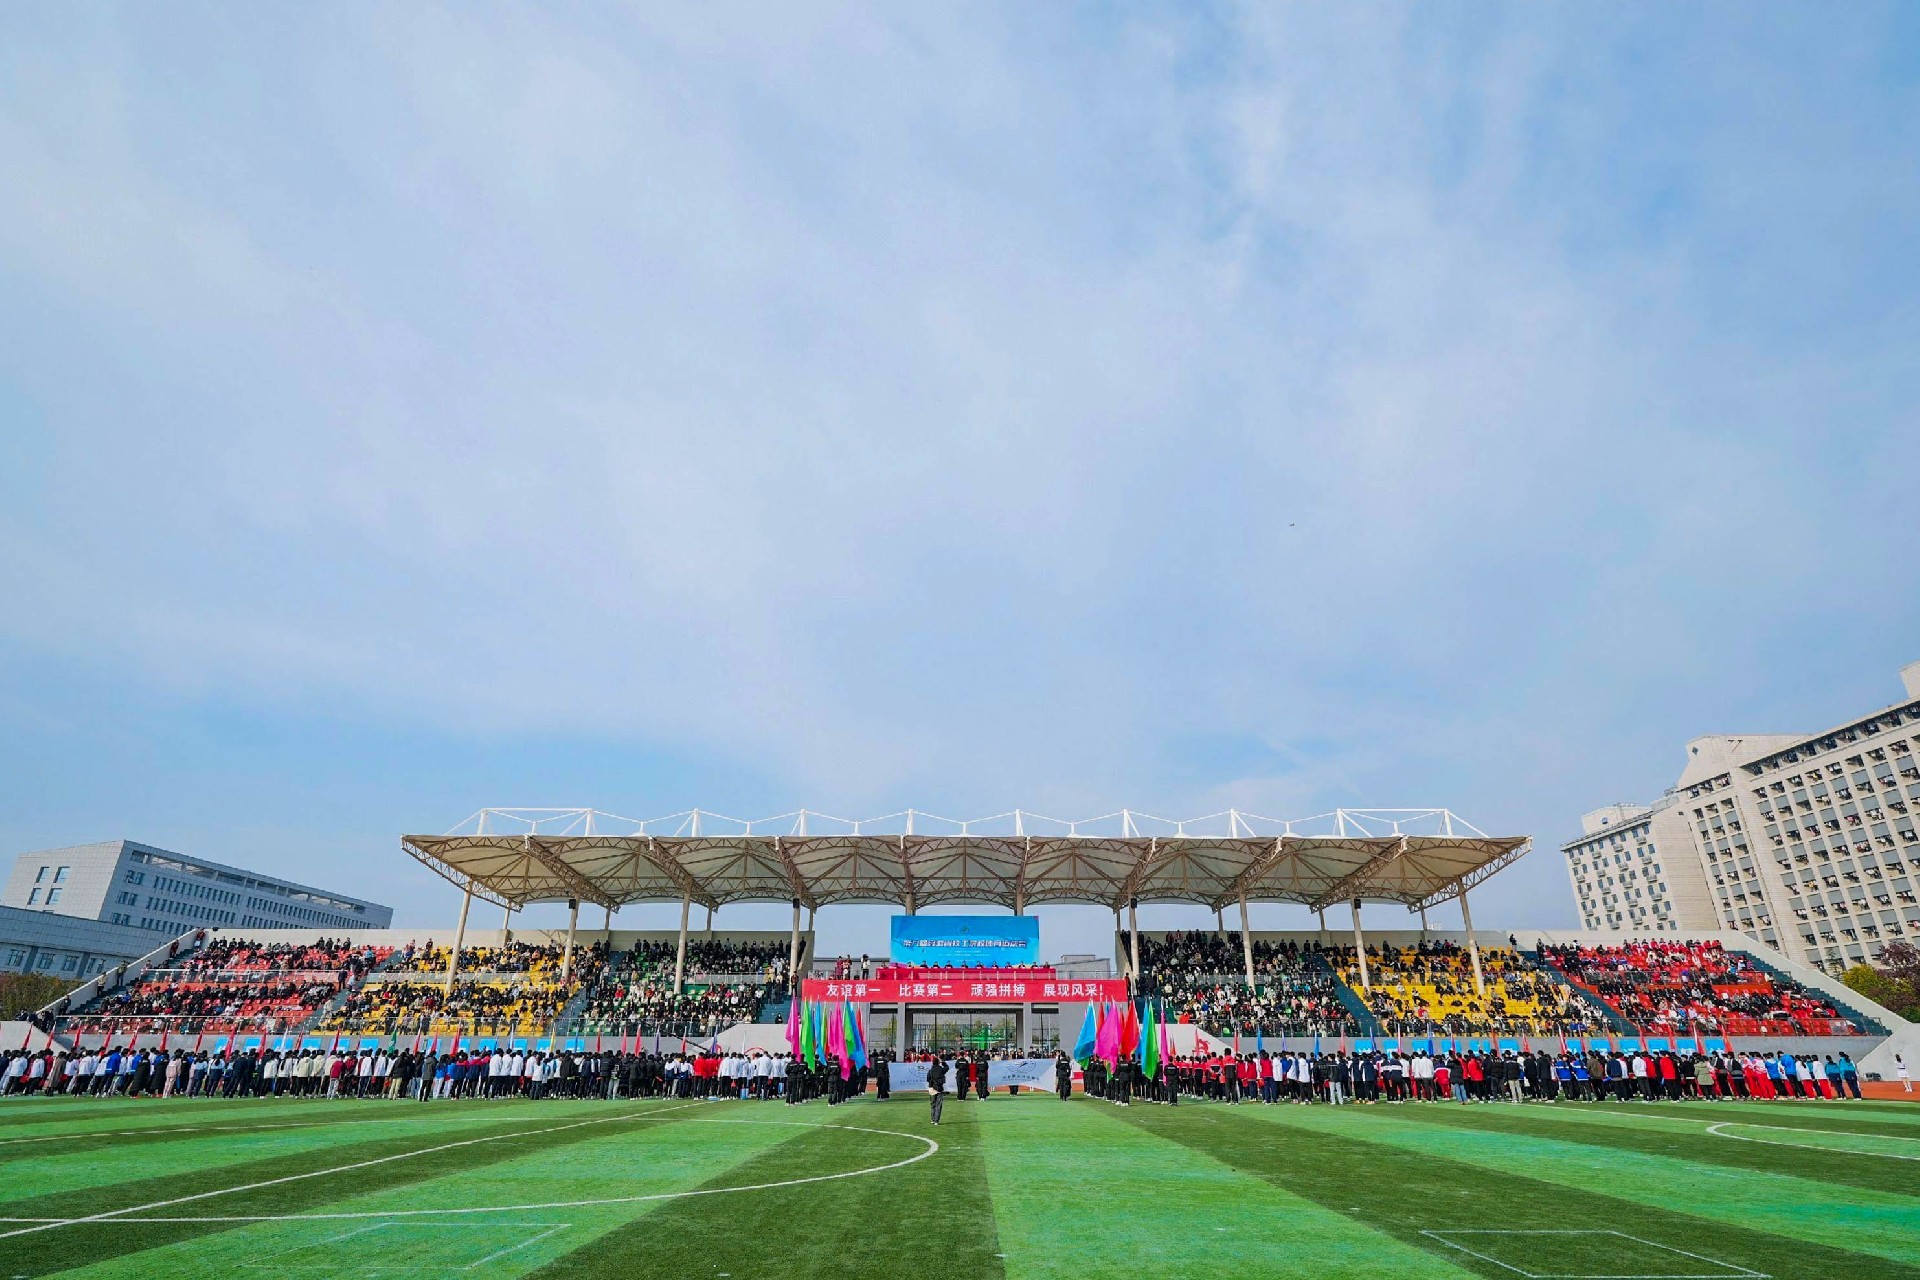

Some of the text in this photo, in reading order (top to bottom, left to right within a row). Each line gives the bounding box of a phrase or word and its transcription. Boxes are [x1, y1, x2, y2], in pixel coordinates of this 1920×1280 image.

[826, 983, 881, 997] 友谊第一
[899, 983, 953, 997] 比赛第二
[970, 983, 1026, 997] 顽强拼搏
